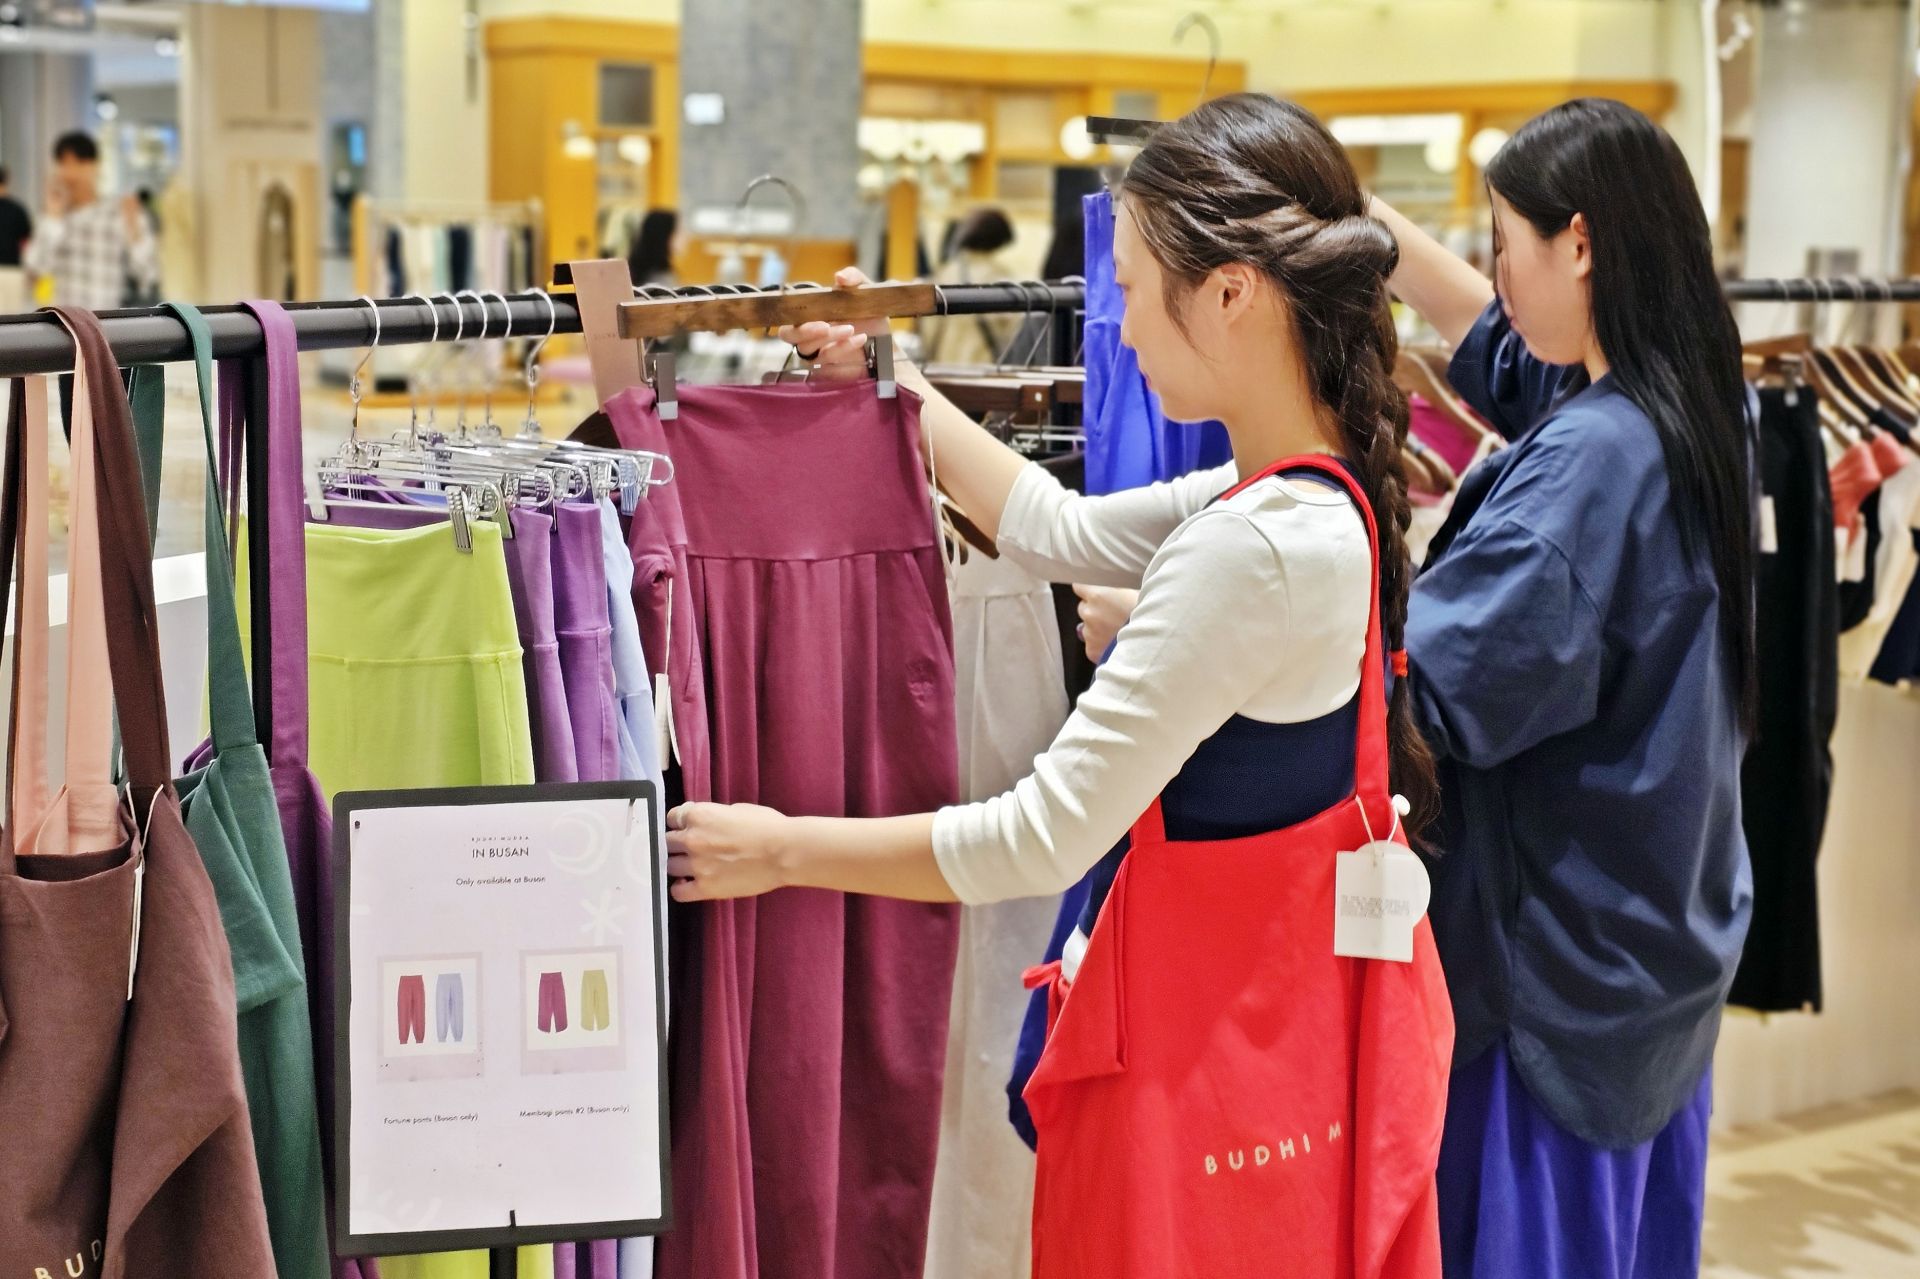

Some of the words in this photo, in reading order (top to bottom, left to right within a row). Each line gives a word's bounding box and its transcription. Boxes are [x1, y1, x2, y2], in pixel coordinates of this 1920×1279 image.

[472, 848, 485, 858] IN
[489, 847, 529, 858] BUSAN
[456, 877, 475, 886] Only
[477, 876, 512, 885] available
[555, 1109, 573, 1117] pants
[413, 1117, 432, 1125] pants
[1204, 1133, 1311, 1175] BUDHI
